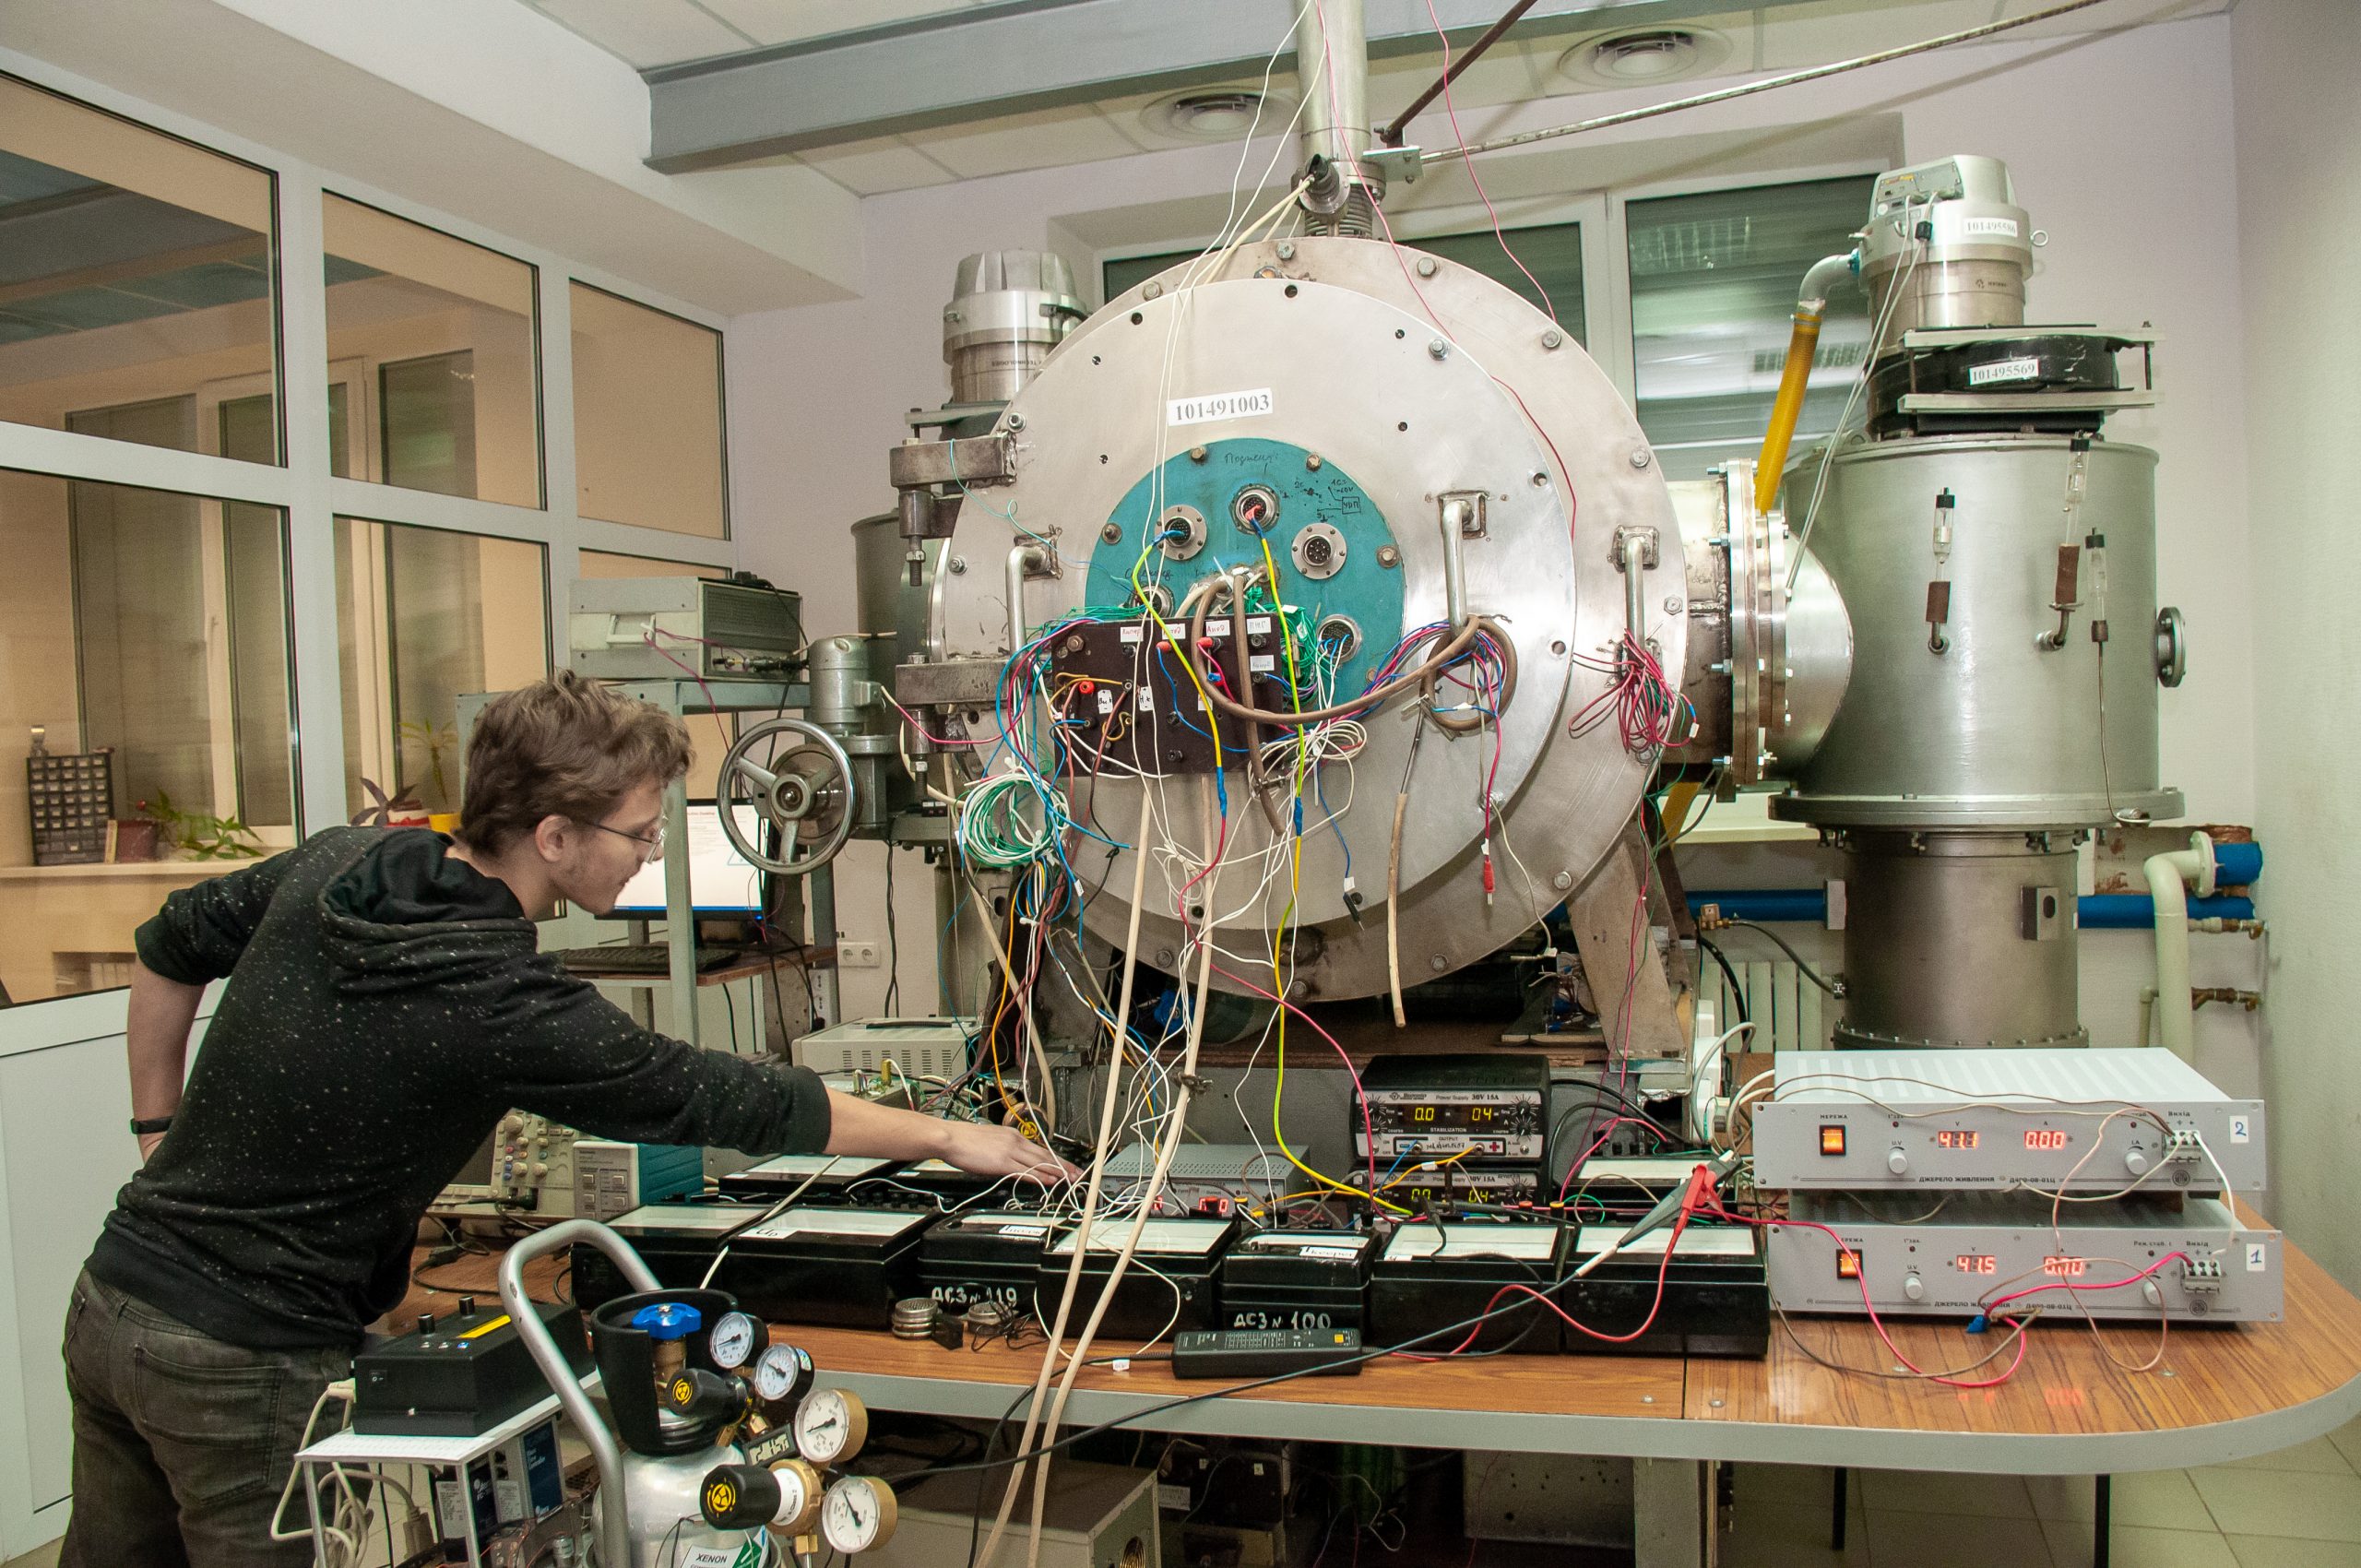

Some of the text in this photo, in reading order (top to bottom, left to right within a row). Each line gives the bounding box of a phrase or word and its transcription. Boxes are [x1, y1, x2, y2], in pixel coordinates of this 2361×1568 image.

[1974, 364, 2035, 381] 101495569
[1176, 395, 1270, 421] 101491003
[2236, 1122, 2247, 1136] 2
[2250, 1249, 2261, 1264] 1
[1290, 1311, 1332, 1330] 100
[695, 1553, 728, 1563] XENON
